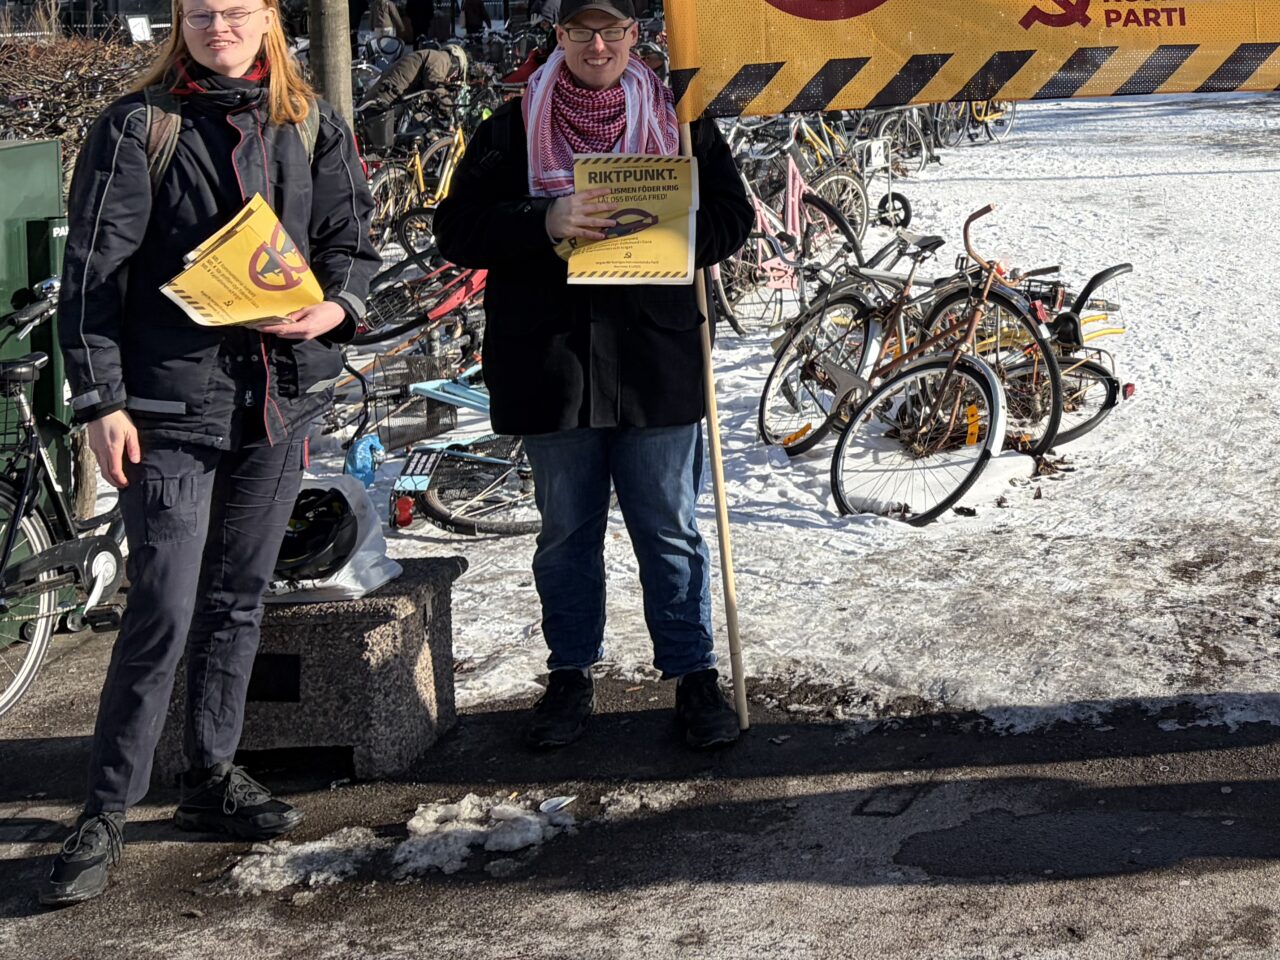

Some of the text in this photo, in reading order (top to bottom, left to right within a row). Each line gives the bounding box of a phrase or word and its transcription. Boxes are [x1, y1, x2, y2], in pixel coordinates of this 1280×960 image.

[1104, 7, 1186, 28] PARTI
[588, 168, 678, 185] RIKTPUNKT.
[638, 185, 662, 193] FÖDER
[662, 184, 679, 192] KRIG
[625, 194, 647, 202] BYGGA
